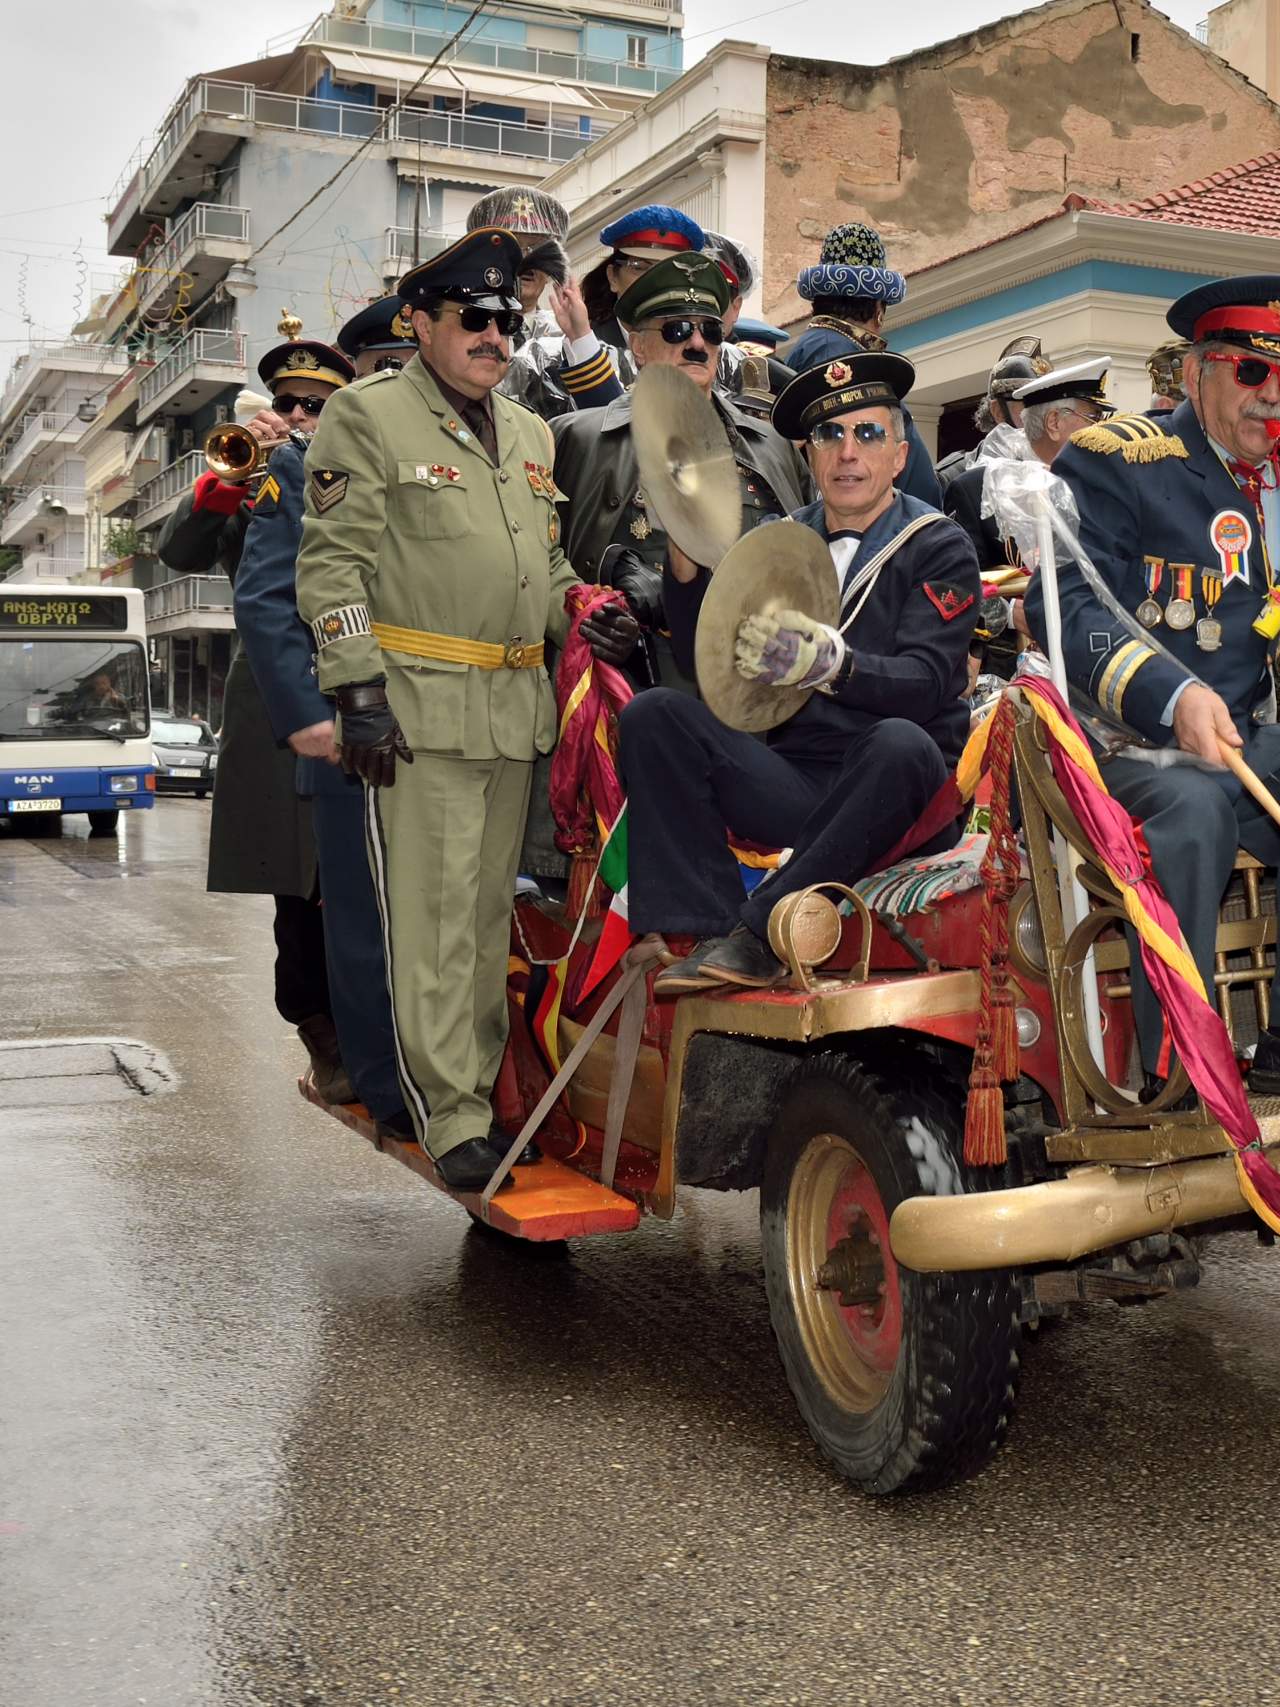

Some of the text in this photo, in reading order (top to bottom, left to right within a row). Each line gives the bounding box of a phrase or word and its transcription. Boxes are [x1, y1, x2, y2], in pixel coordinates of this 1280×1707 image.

[3, 601, 92, 614] ΑΝΩ-ΚΑΤΩ
[17, 613, 78, 625] ΟΒΡΥΑ
[14, 775, 54, 784] MAN
